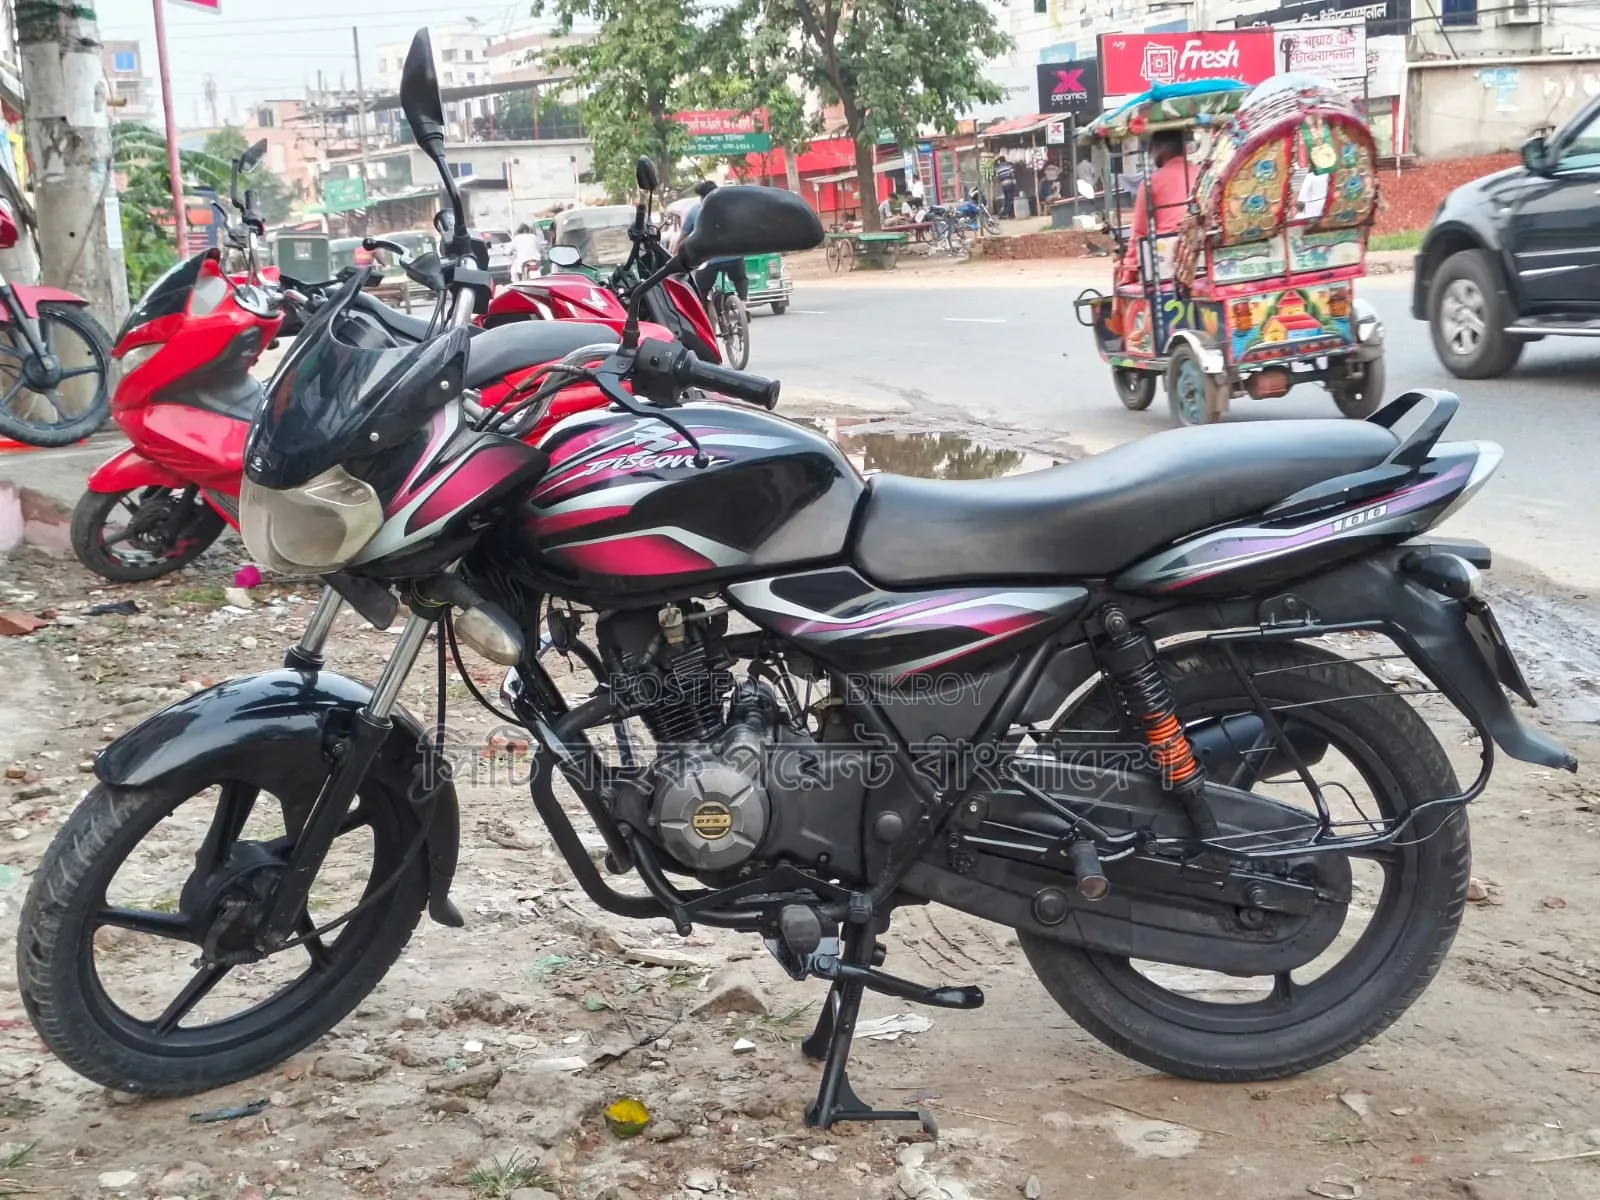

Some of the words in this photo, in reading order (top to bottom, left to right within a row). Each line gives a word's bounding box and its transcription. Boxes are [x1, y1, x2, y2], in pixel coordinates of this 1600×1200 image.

[1180, 39, 1240, 70] Fresh
[1051, 91, 1088, 102] ceramics
[1332, 504, 1388, 533] 100
